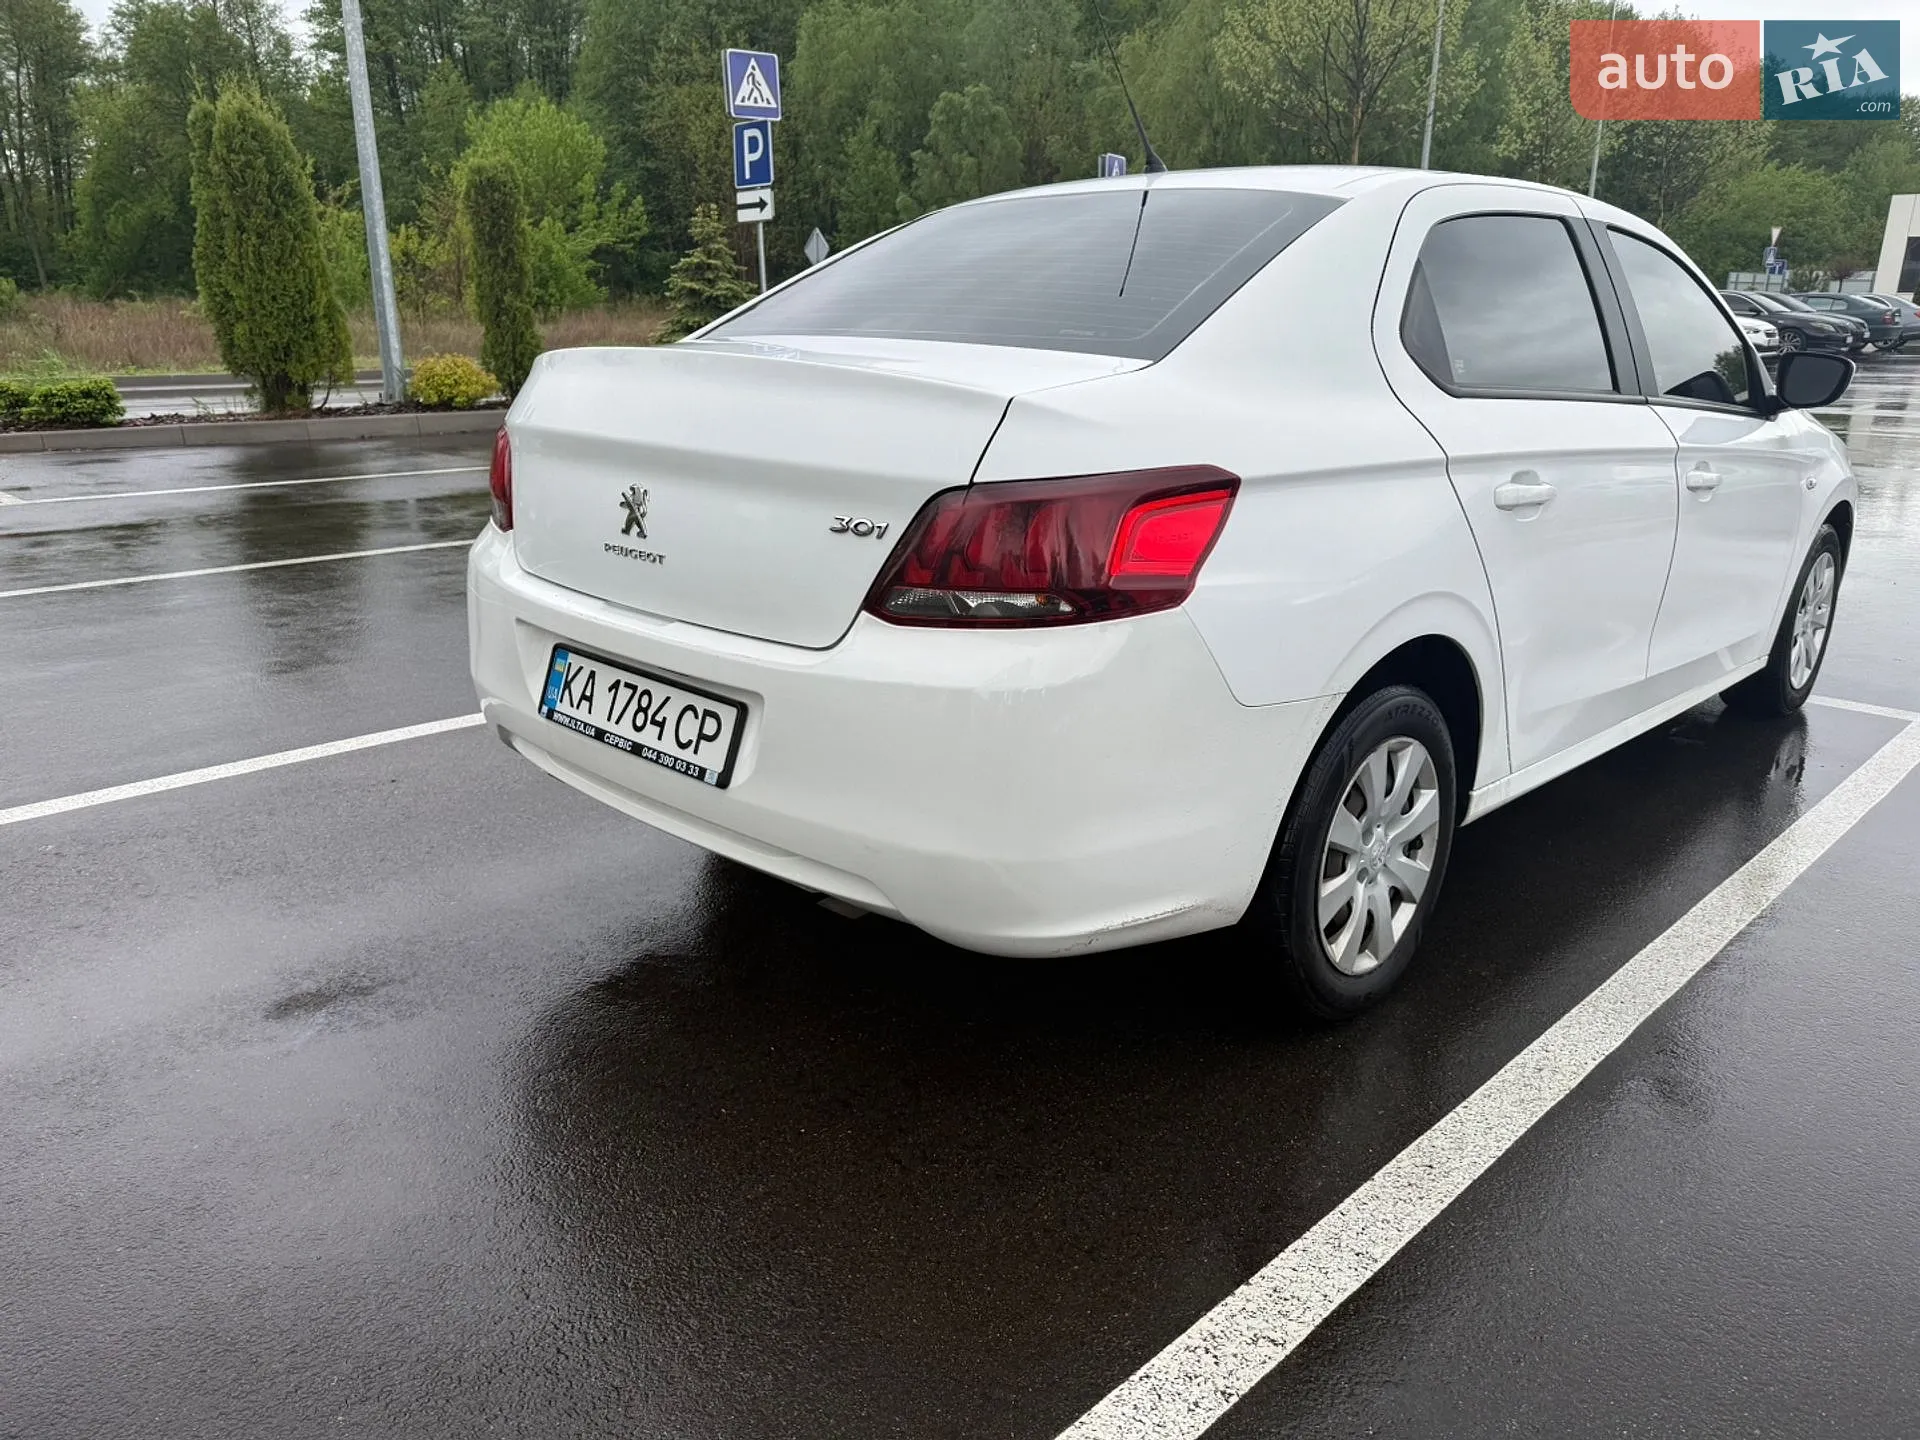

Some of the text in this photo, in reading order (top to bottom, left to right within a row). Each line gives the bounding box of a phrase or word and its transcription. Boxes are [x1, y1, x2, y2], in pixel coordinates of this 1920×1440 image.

[743, 128, 764, 180] P
[829, 515, 889, 539] 301
[603, 542, 666, 565] PEUGEOT
[559, 662, 722, 755] KA 1784 CP
[603, 733, 633, 751] СЕРВІС
[641, 747, 700, 777] 044 390 03 33
